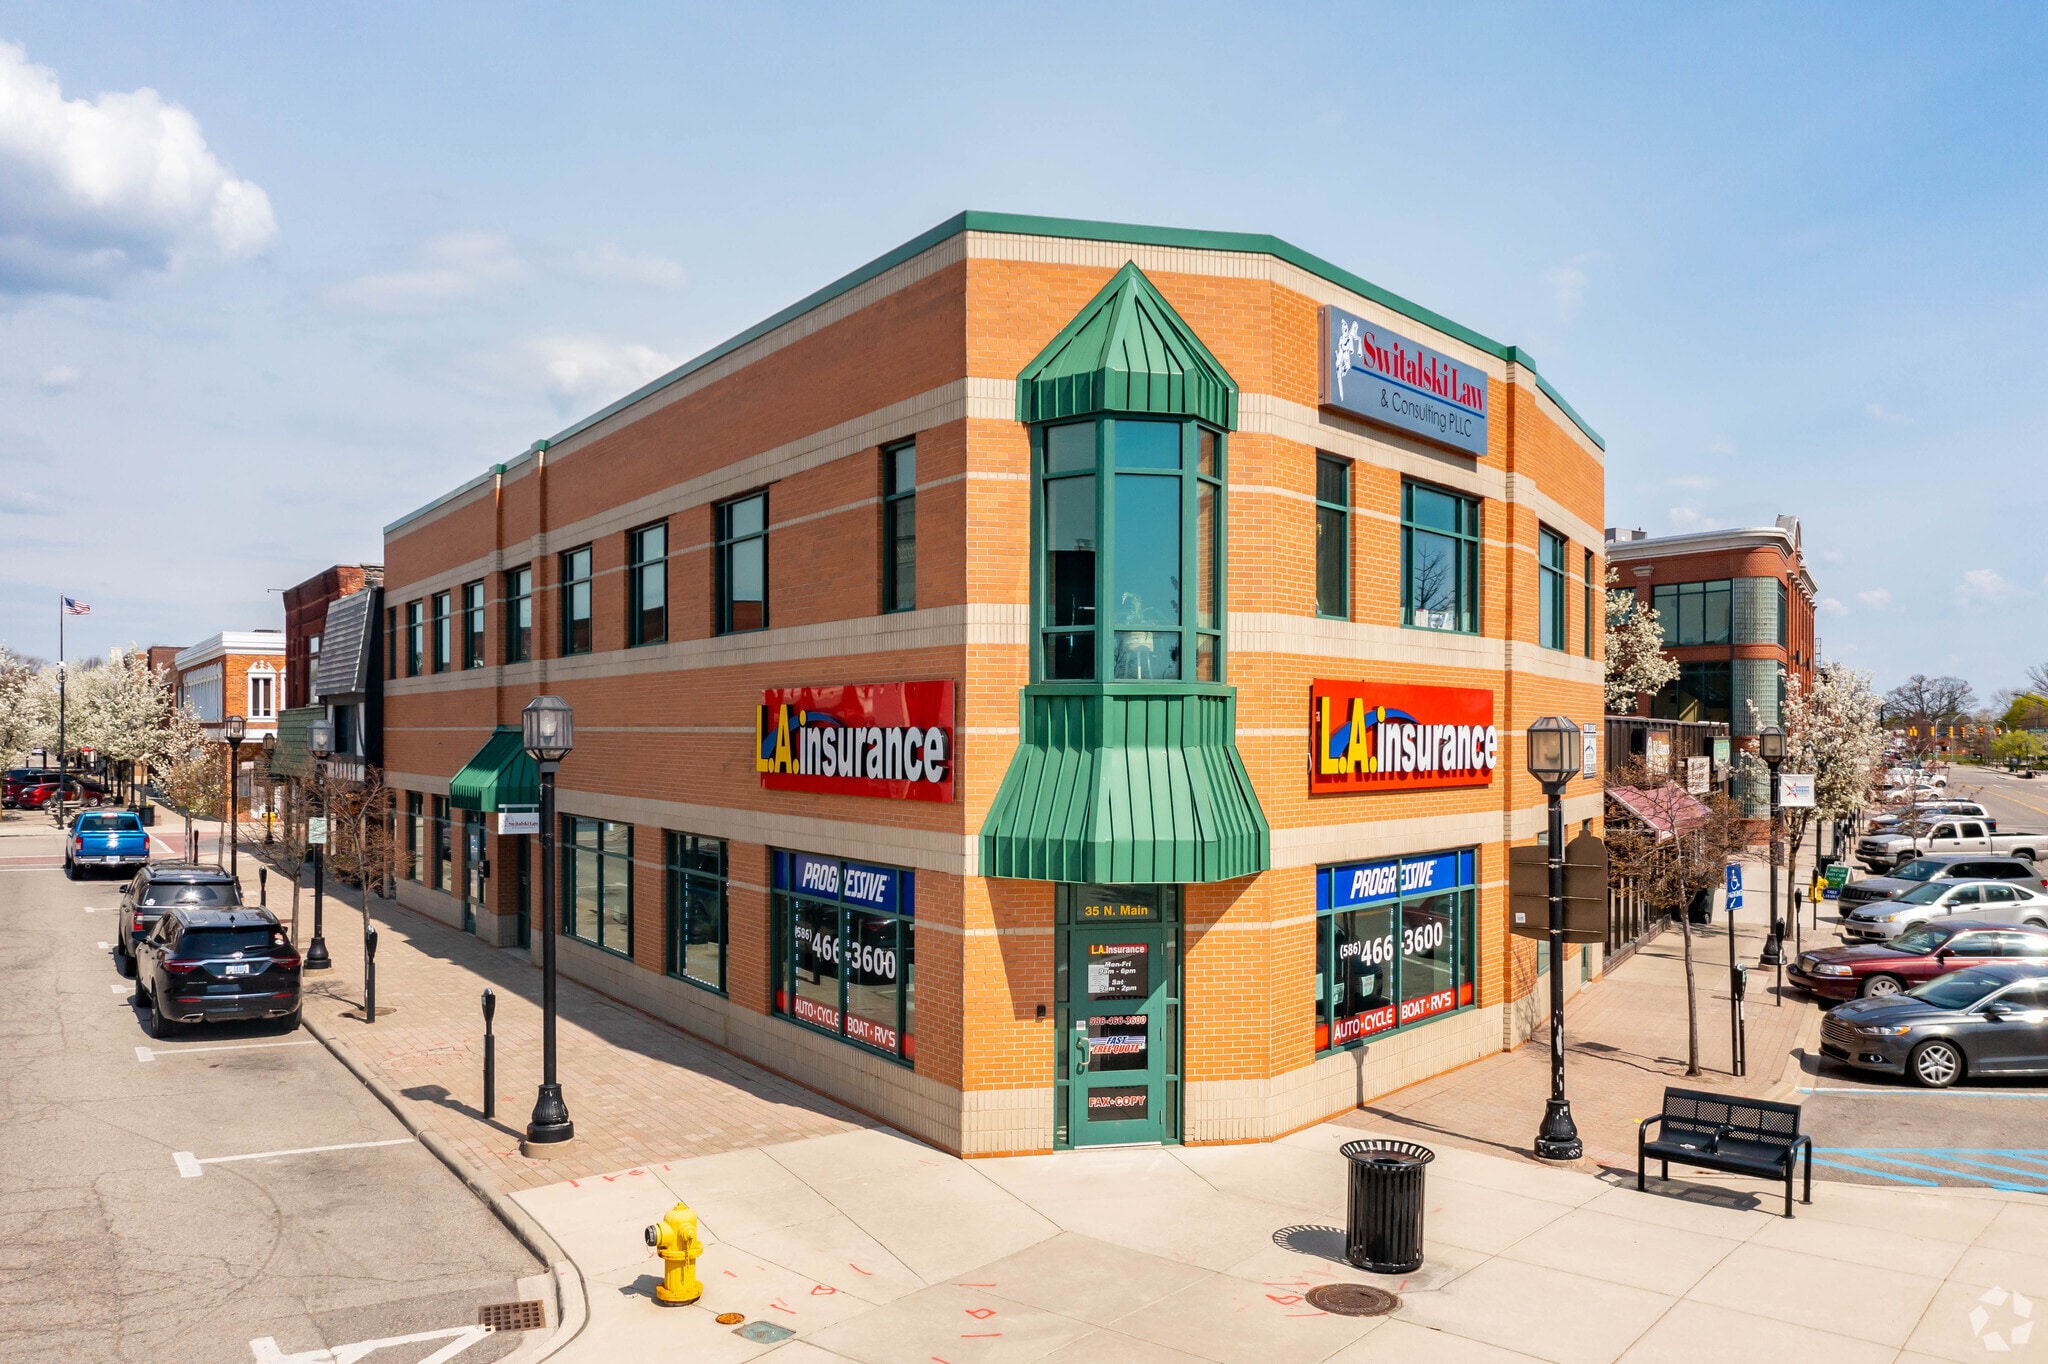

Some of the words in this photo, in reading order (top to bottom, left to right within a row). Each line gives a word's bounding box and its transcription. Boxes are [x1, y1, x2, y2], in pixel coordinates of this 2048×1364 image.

[1363, 332, 1448, 398] Switalski
[1452, 367, 1485, 411] Law
[1381, 389, 1389, 408] &
[1392, 392, 1447, 432] Consulting
[1450, 413, 1472, 438] PLLC
[1350, 860, 1435, 899] PROGRESSIVE
[1084, 905, 1100, 916] 35
[1103, 905, 1116, 916] N.
[1120, 904, 1149, 915] Main
[794, 925, 812, 942] (586)
[1339, 941, 1361, 960] (586)
[1120, 967, 1136, 975] 6pm
[1099, 984, 1115, 992] 9m
[1121, 984, 1137, 992] 2pm
[795, 998, 813, 1018] AUTO
[817, 1006, 839, 1027] CYCLE
[847, 1016, 870, 1038] BOAT
[874, 1026, 896, 1047] RV'S
[1334, 1016, 1360, 1041] AUTO
[1364, 1008, 1393, 1032] CYCLE
[1401, 999, 1426, 1020] BOAT
[1430, 991, 1452, 1012] RV'S
[1092, 1045, 1112, 1054] FREE
[1113, 1044, 1140, 1054] QUOTE
[1106, 1036, 1128, 1045] FAST
[1089, 1097, 1110, 1107] FAX
[1115, 1095, 1146, 1106] COPY
